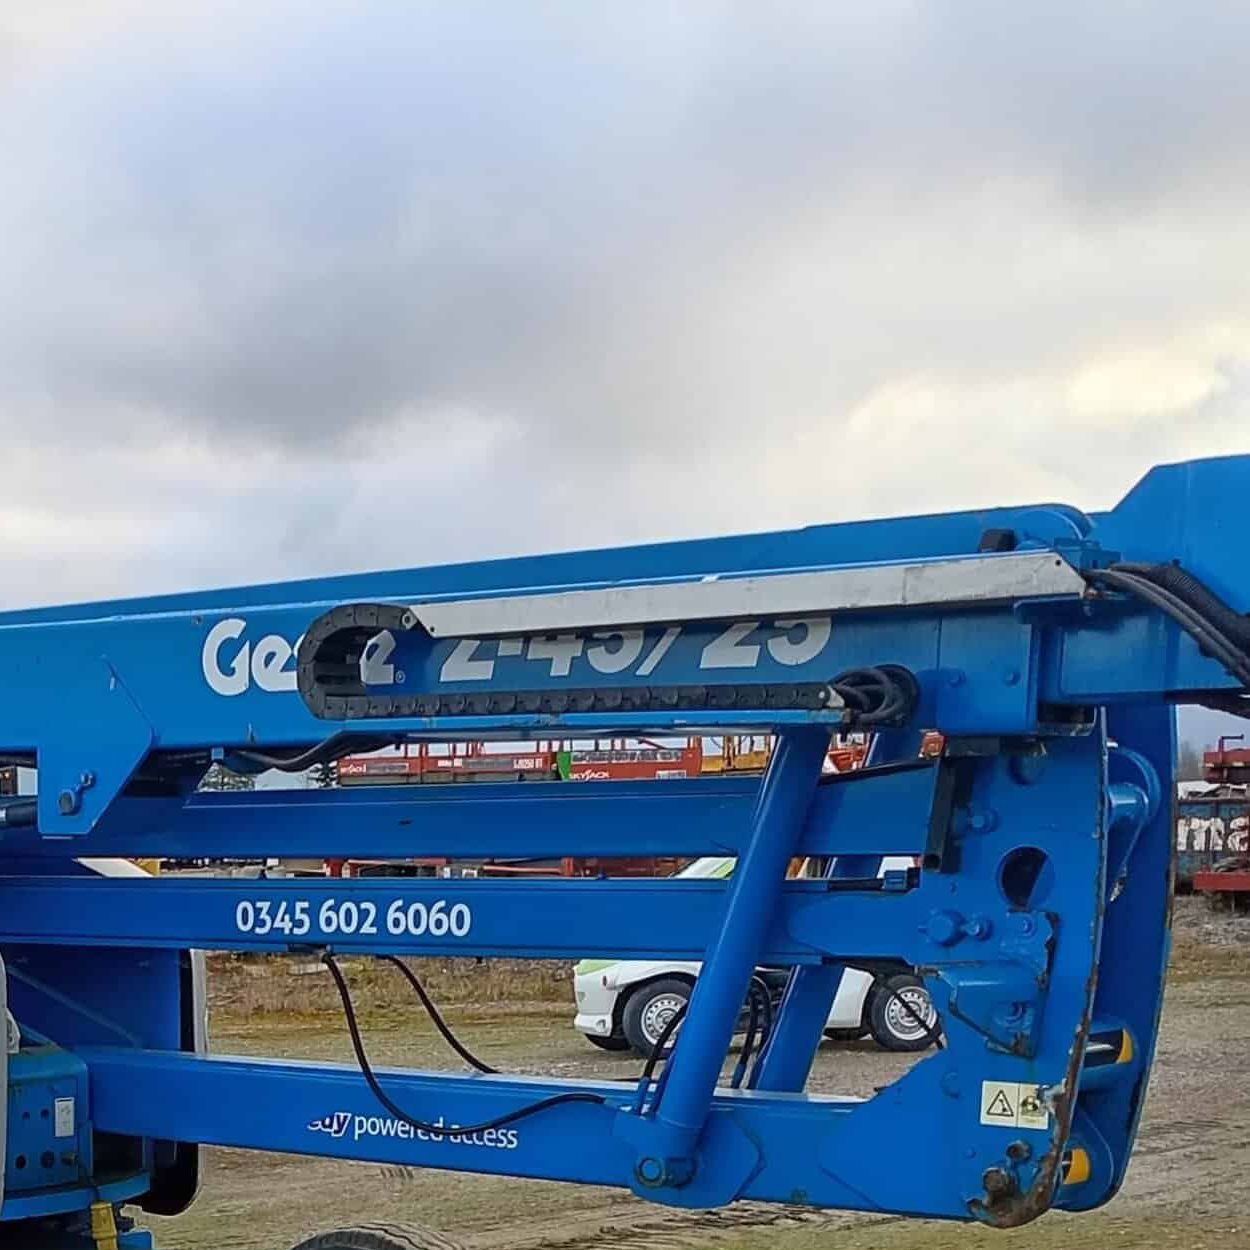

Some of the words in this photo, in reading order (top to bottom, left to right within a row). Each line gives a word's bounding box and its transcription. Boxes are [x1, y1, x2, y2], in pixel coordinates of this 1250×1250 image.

[236, 900, 311, 935] 0345
[319, 899, 378, 934] 602
[386, 899, 471, 937] 6060
